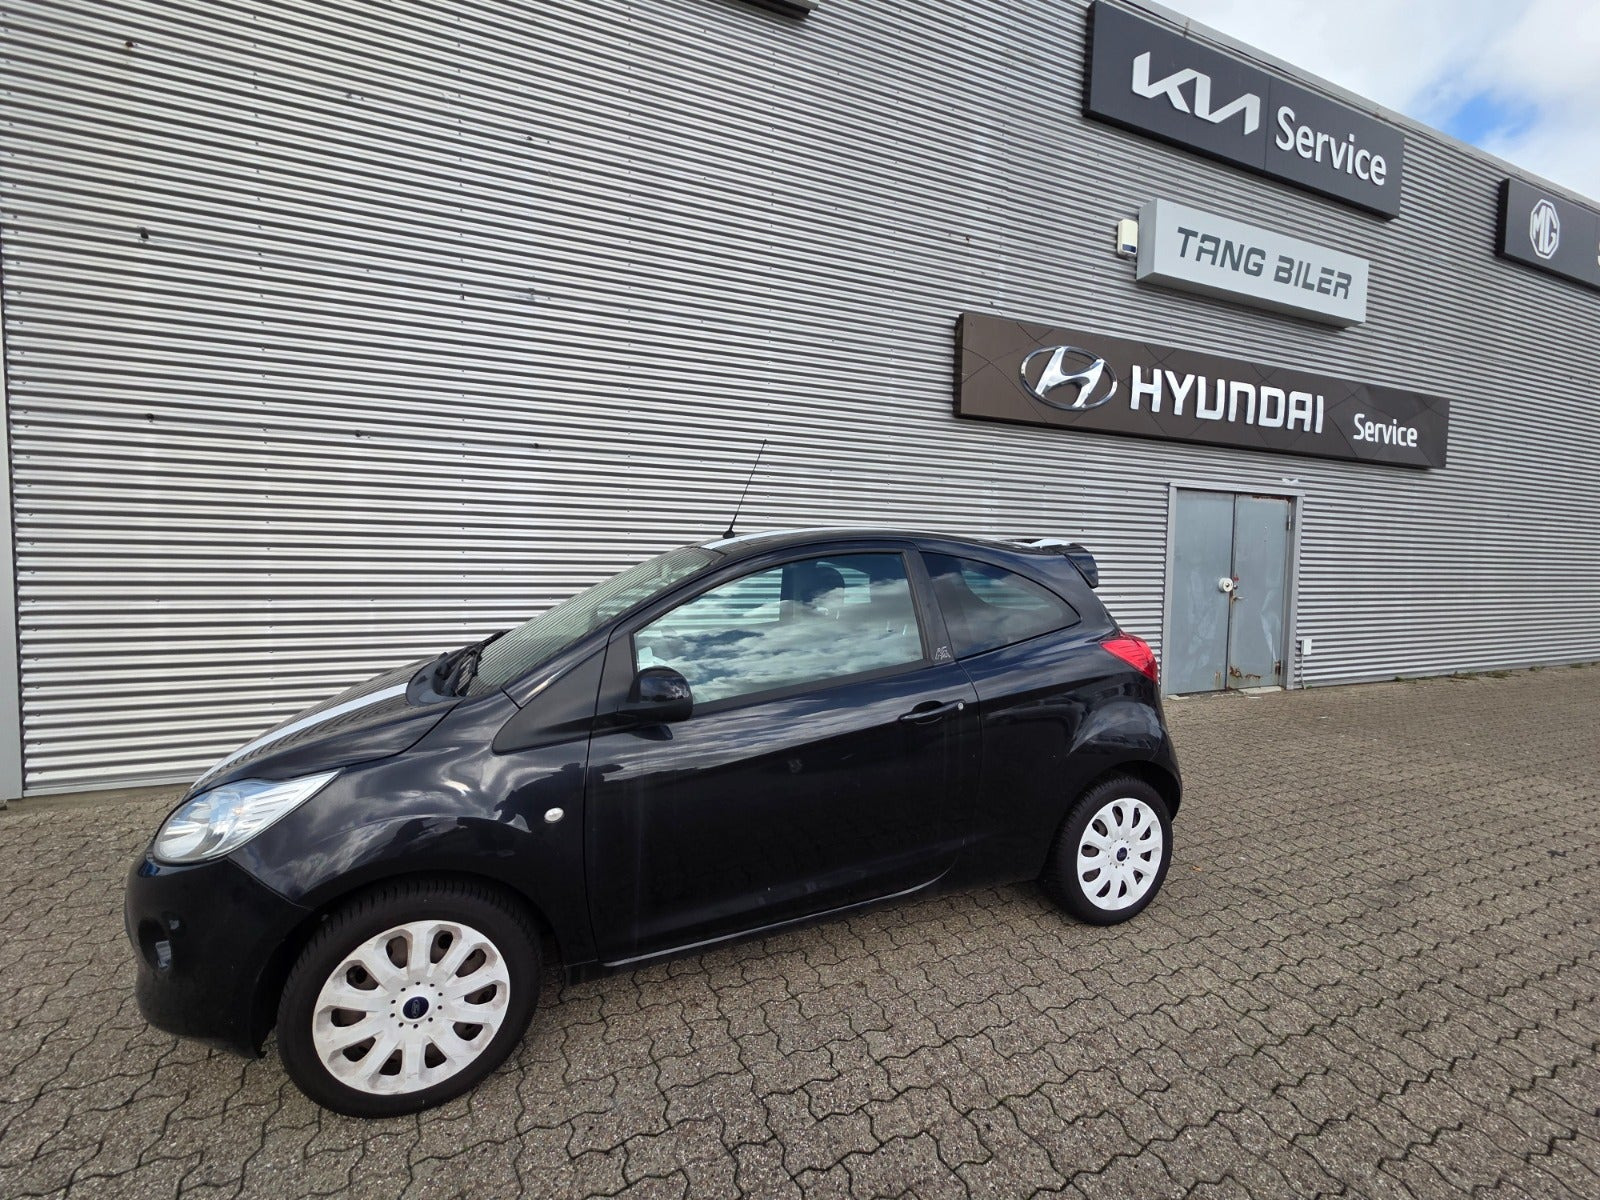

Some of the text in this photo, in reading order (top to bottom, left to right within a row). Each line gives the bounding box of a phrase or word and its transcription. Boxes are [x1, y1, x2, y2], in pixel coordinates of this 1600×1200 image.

[1275, 106, 1387, 186] Service
[1178, 227, 1352, 299] TANG BILER
[1532, 204, 1558, 254] MG
[1130, 365, 1418, 448] HYUNDAI Service
